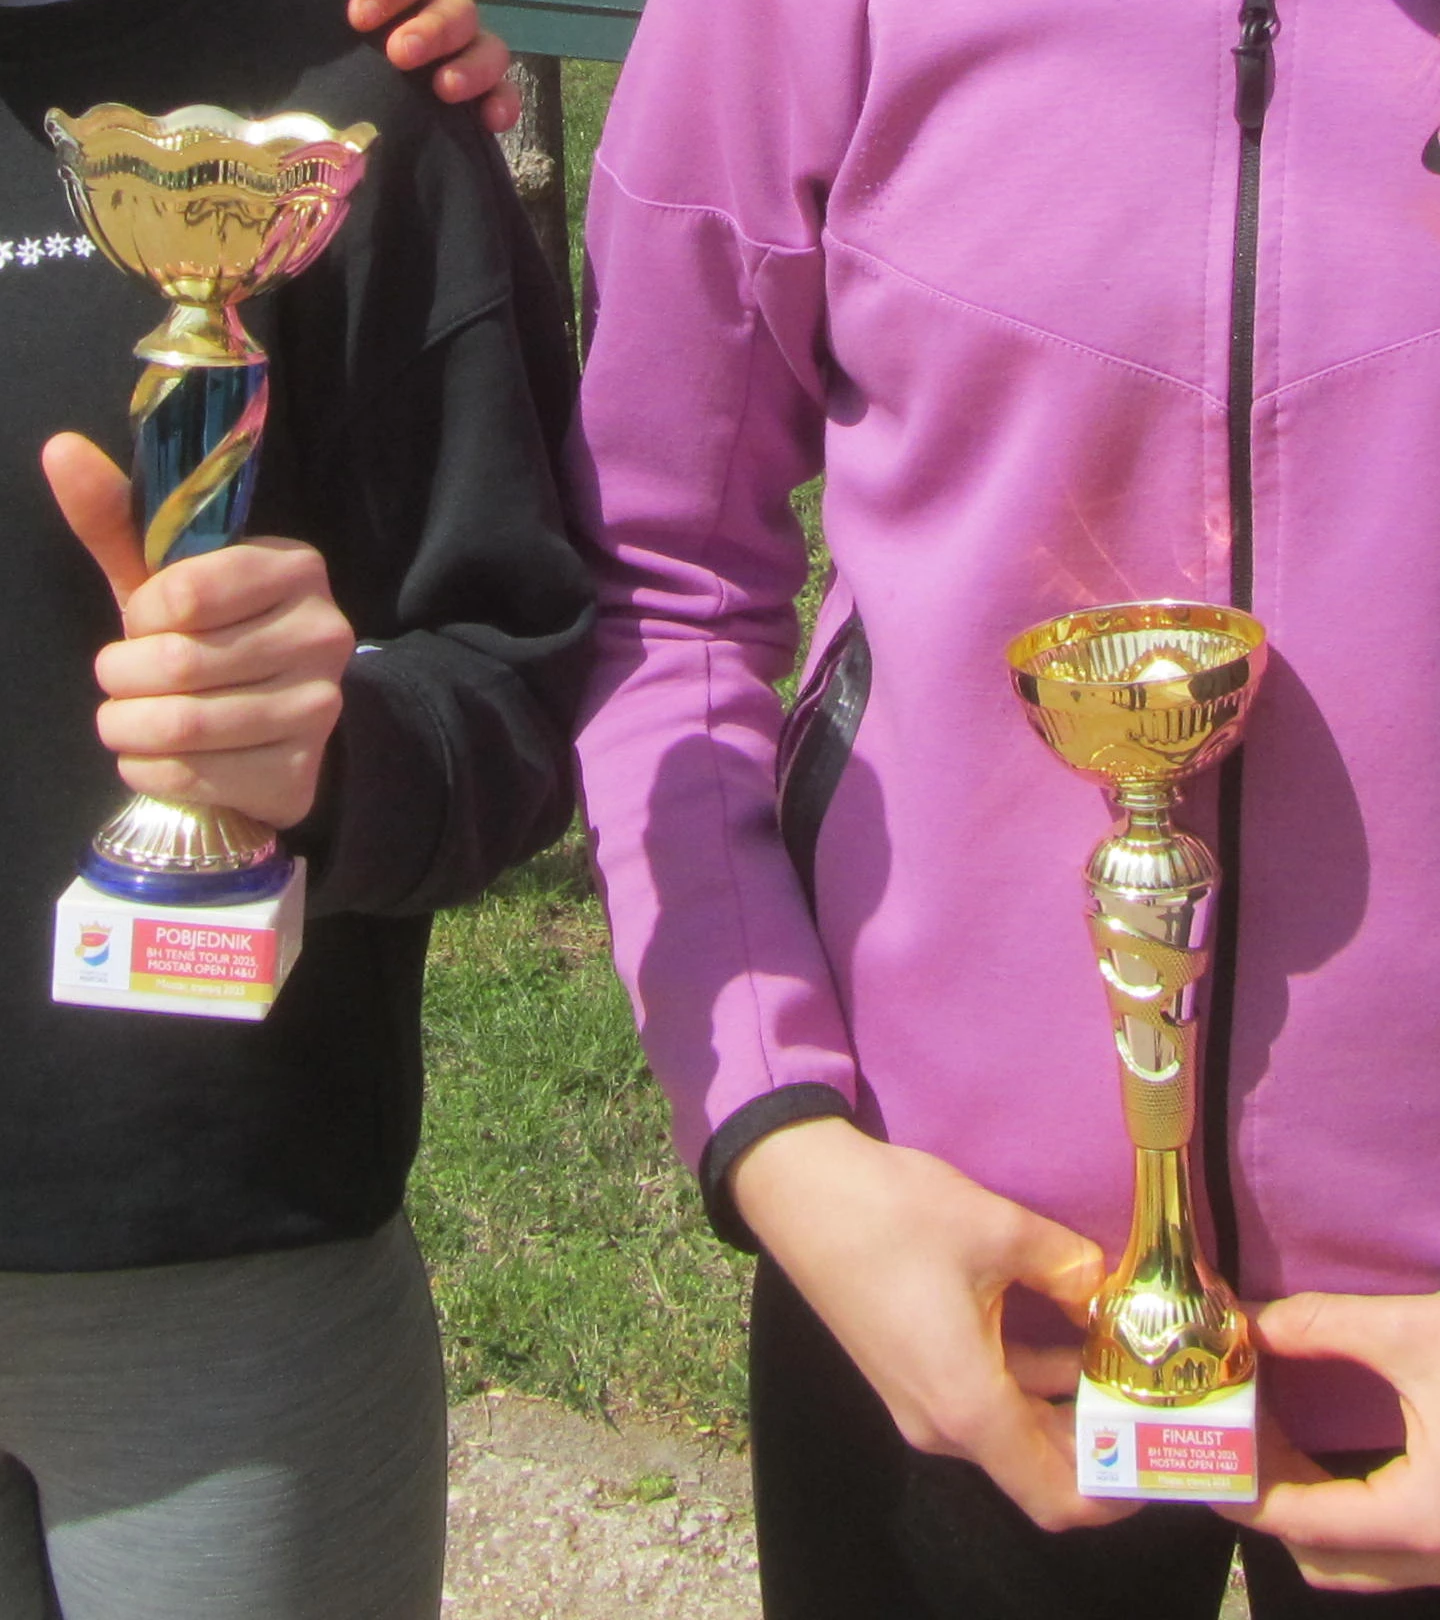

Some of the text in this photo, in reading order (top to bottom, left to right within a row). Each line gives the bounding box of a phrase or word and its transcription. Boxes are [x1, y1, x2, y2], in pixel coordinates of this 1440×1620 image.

[156, 927, 252, 951] POBJEDNIK
[146, 947, 162, 958] BH
[165, 948, 195, 962] TENIS
[199, 952, 230, 964] TOUR
[148, 960, 257, 978] MOSTAR OPEN 14&U
[1163, 1428, 1224, 1446] FINALIST
[1190, 1449, 1216, 1459] TOUR
[1150, 1459, 1185, 1469] MOSTAR
[1187, 1460, 1213, 1470] OPEN
